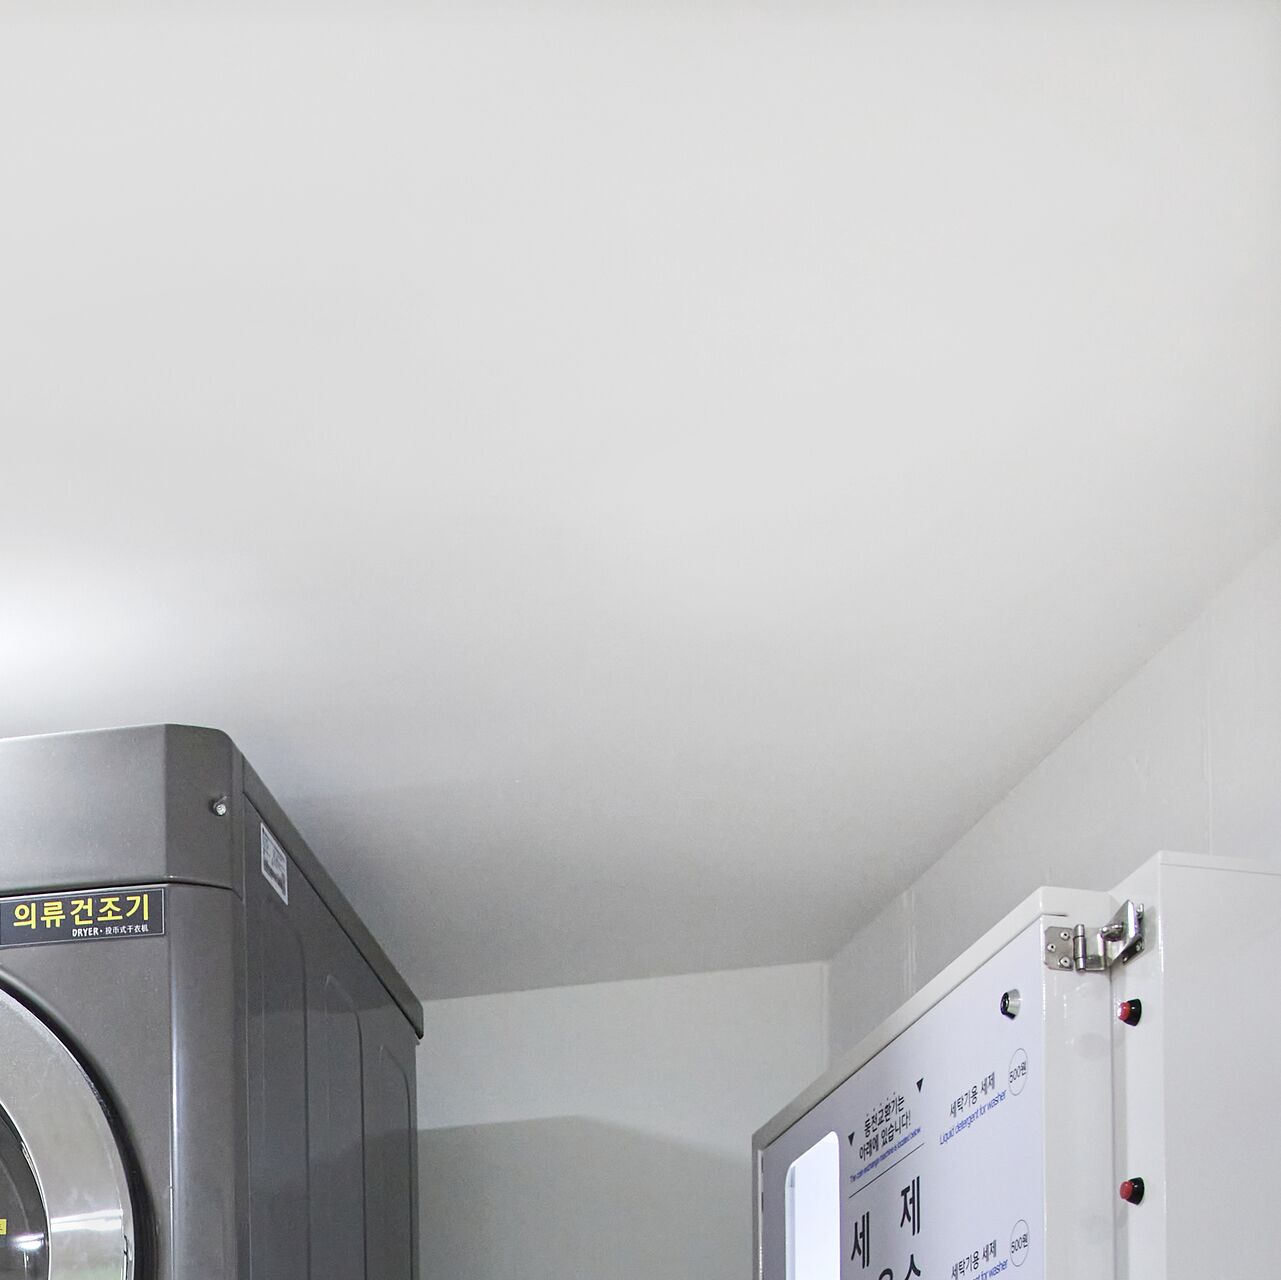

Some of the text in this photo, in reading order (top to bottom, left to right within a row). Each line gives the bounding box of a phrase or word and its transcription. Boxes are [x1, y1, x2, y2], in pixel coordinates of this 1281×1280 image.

[13, 894, 149, 929] 의류건조기
[980, 1071, 995, 1095] 세제
[982, 1240, 996, 1262] 세제
